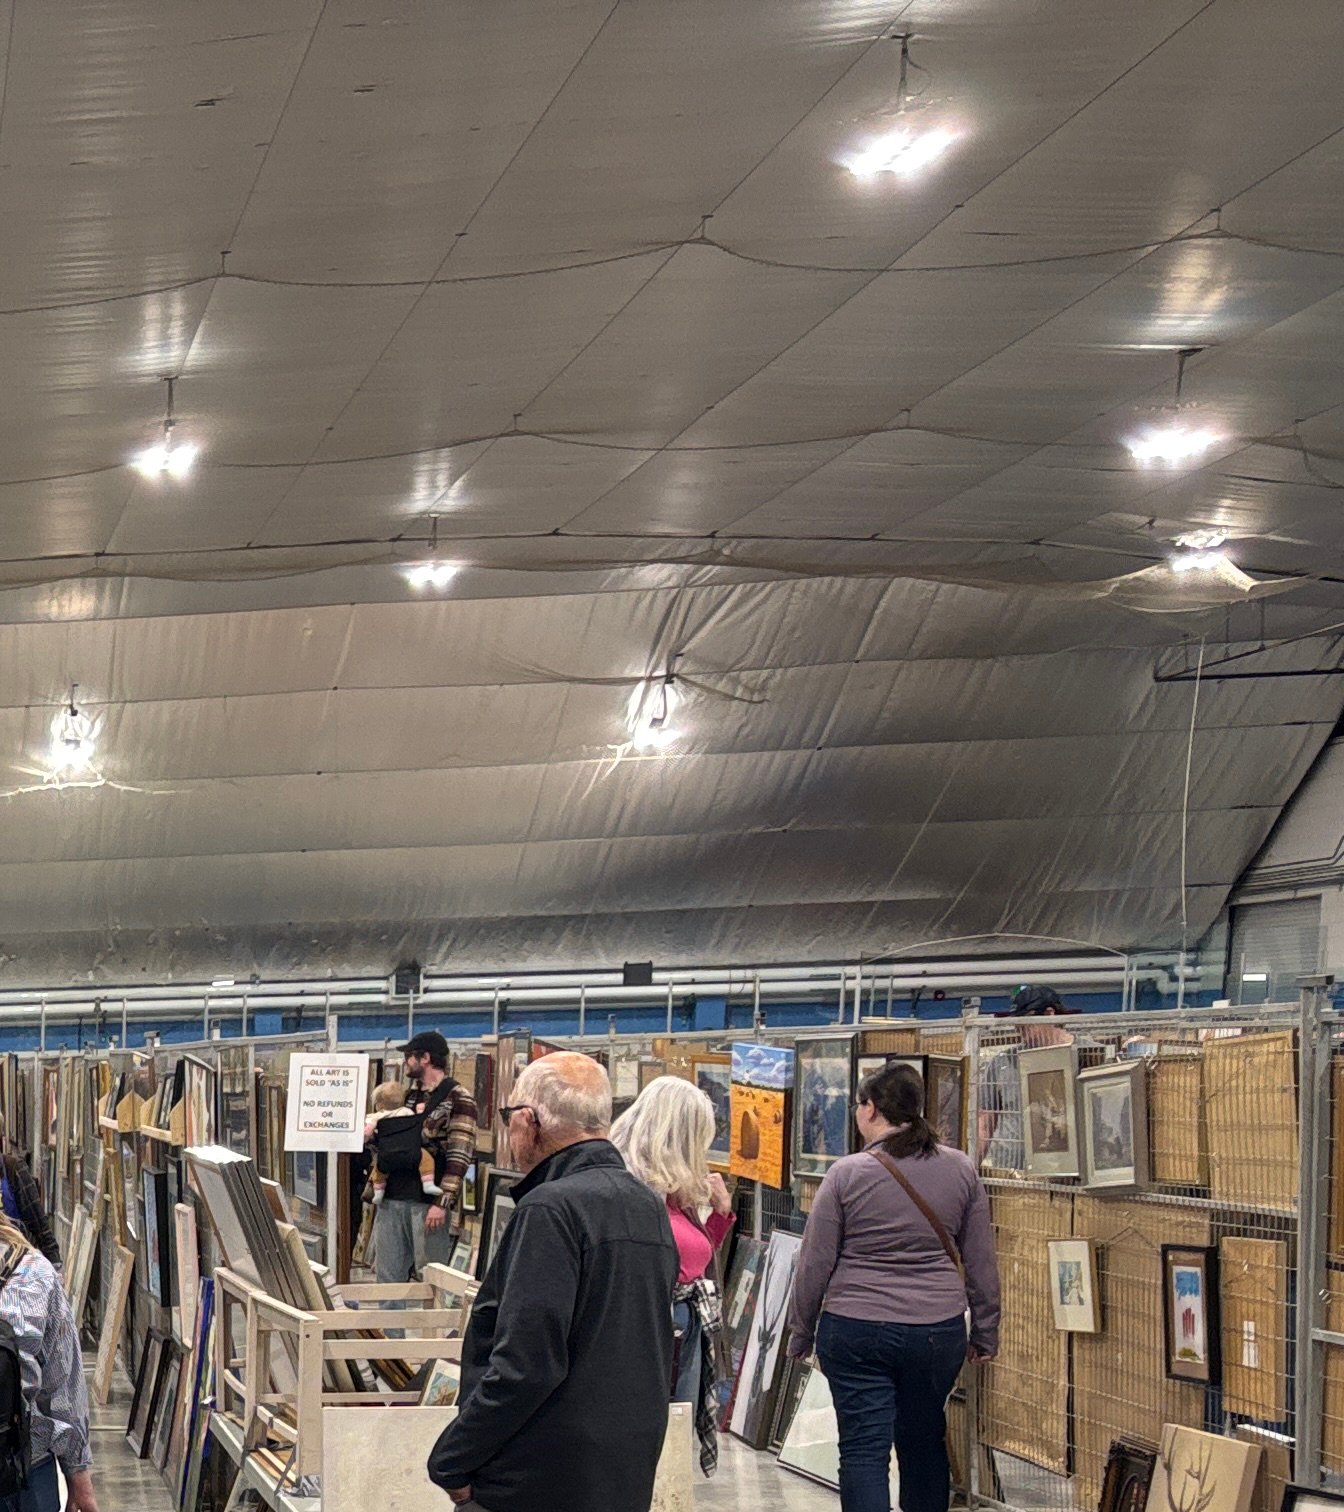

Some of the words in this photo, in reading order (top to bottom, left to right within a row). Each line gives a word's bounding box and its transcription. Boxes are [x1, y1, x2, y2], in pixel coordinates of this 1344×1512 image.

[342, 1069, 350, 1077] IS
[317, 1100, 353, 1108] REFUNDS
[304, 1121, 349, 1129] EXCHANGES
